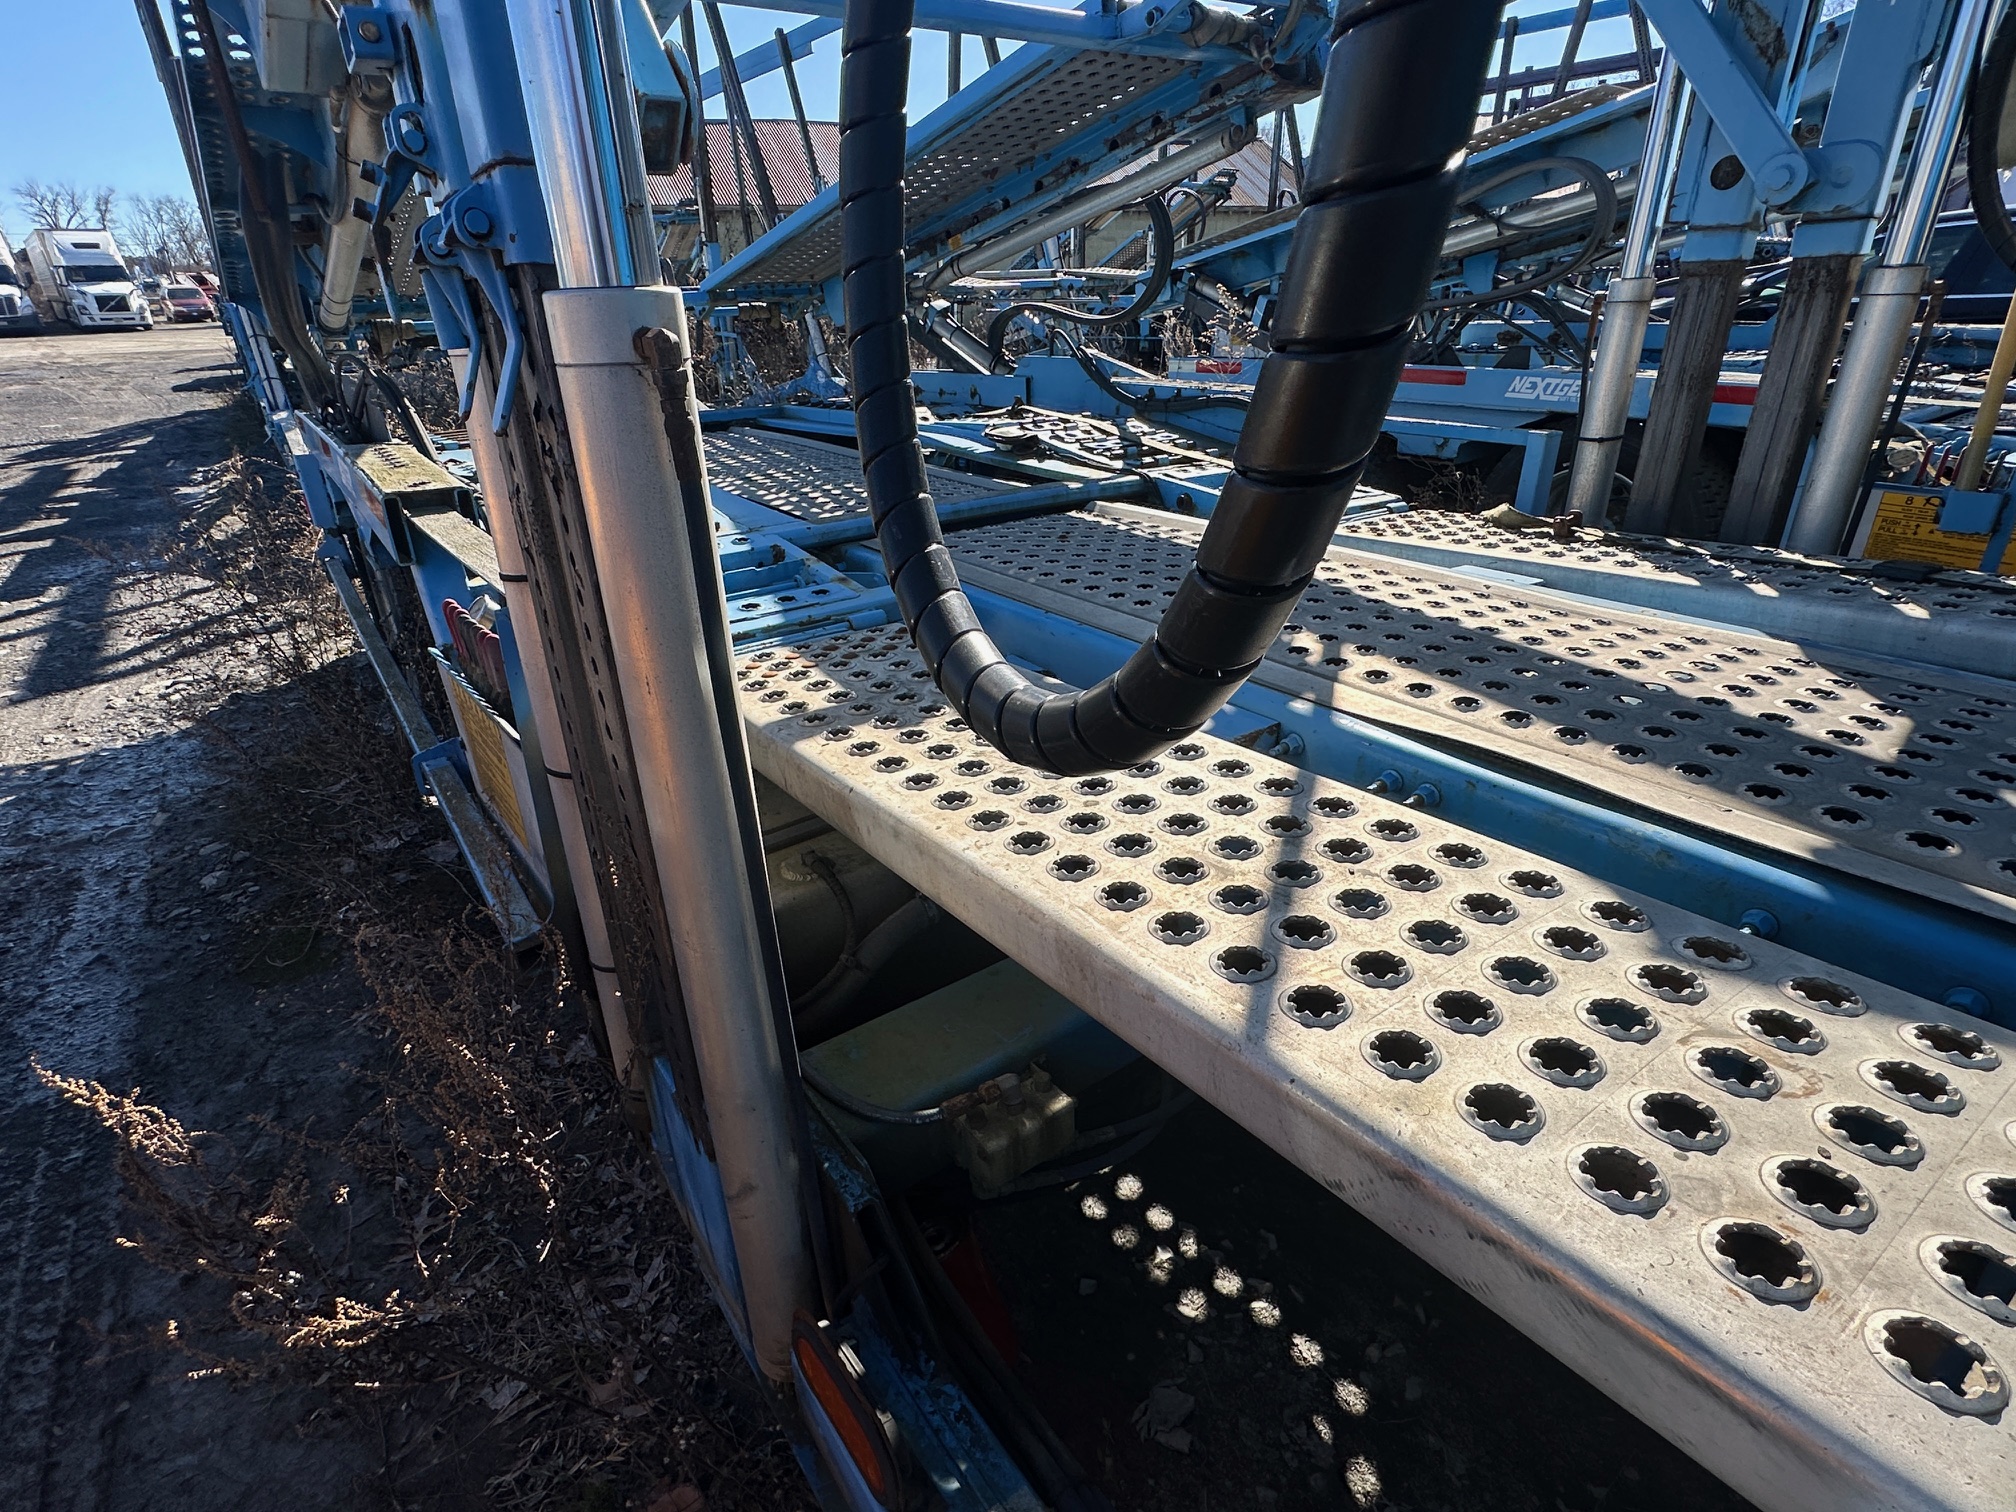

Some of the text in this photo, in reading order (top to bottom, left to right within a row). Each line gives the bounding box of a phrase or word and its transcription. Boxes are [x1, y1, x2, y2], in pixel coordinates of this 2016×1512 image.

[1505, 376, 1581, 402] NEXTGE
[1905, 496, 1914, 505] 8
[1881, 518, 1901, 526] PUSH
[1878, 526, 1896, 534] PULL
